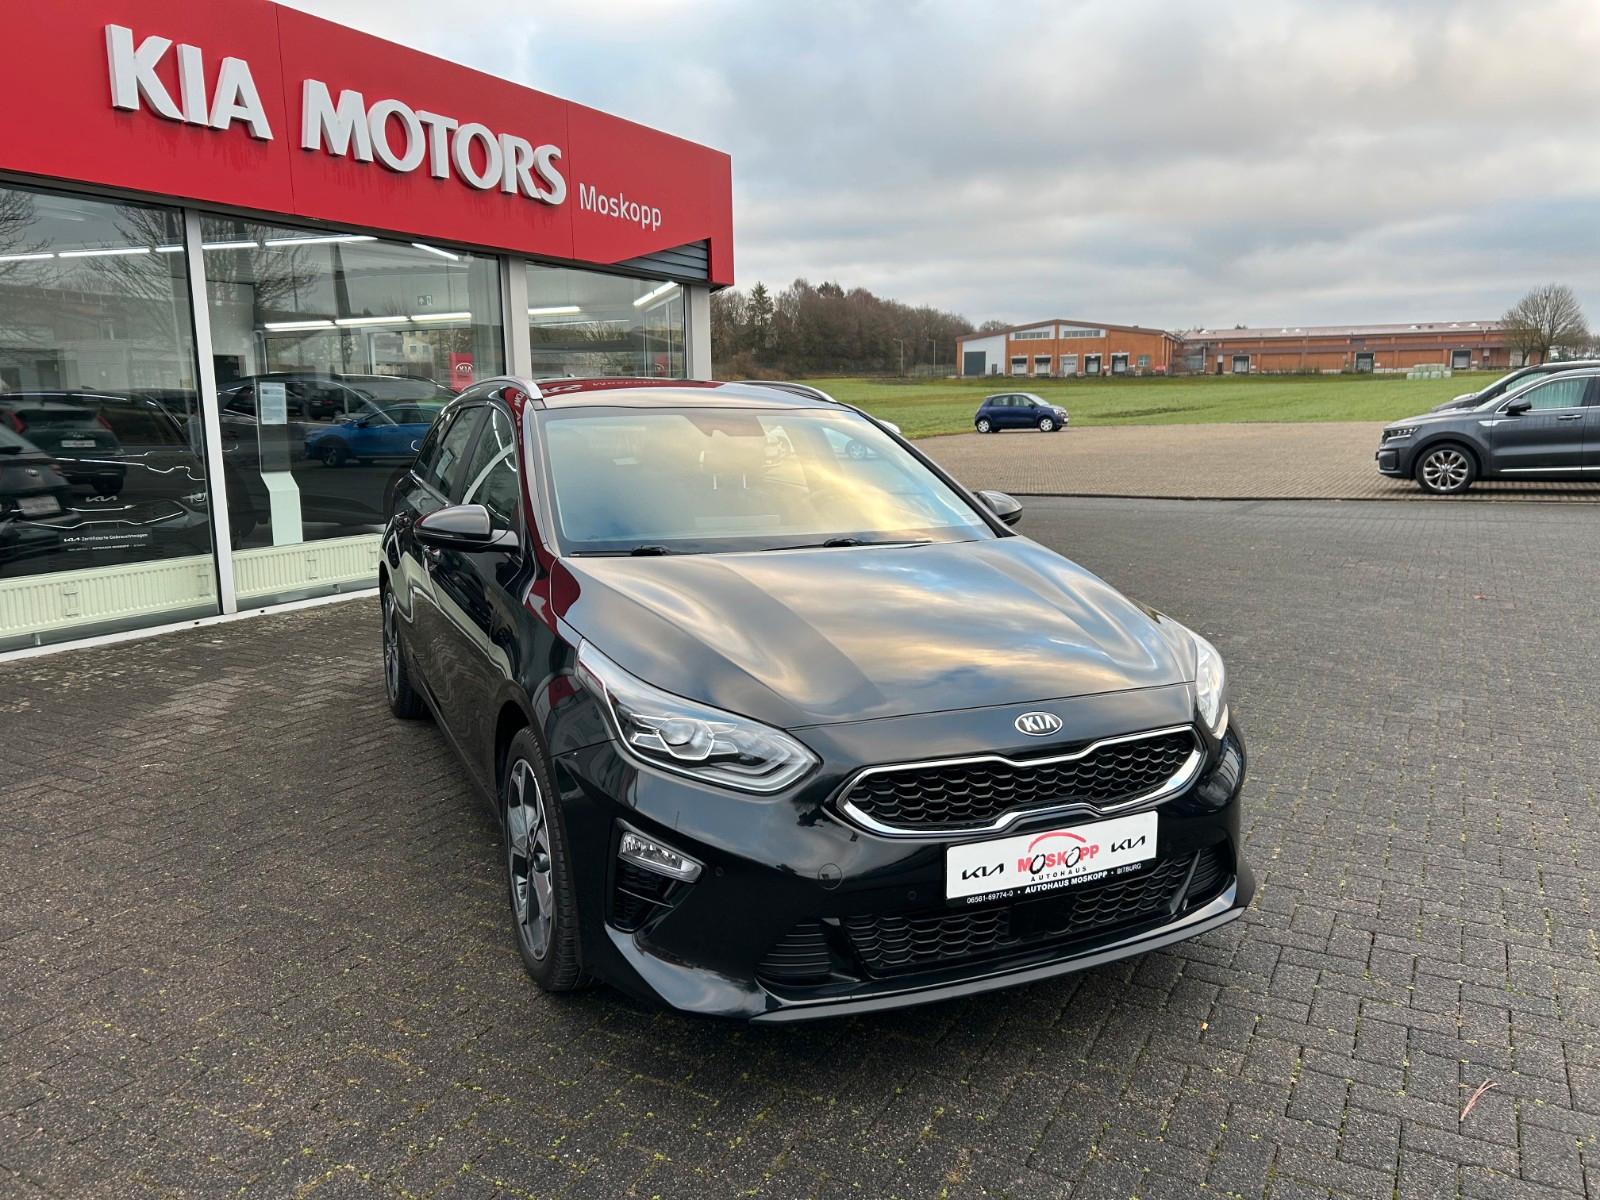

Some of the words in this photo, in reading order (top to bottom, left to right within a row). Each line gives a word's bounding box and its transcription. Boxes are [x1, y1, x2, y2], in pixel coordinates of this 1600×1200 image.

[105, 23, 274, 141] KIA
[301, 79, 567, 206] MOTORS
[579, 183, 662, 231] Moskopp
[1021, 714, 1058, 731] KIA
[1111, 835, 1146, 853] KIA
[1017, 844, 1100, 874] MOSKOPP
[962, 863, 1005, 880] KIA
[1025, 879, 1069, 894] AUTOHAUS
[1071, 871, 1108, 885] MOSKOPP
[1116, 863, 1142, 875] BITBURG
[1031, 866, 1087, 882] AUTOHAUS
